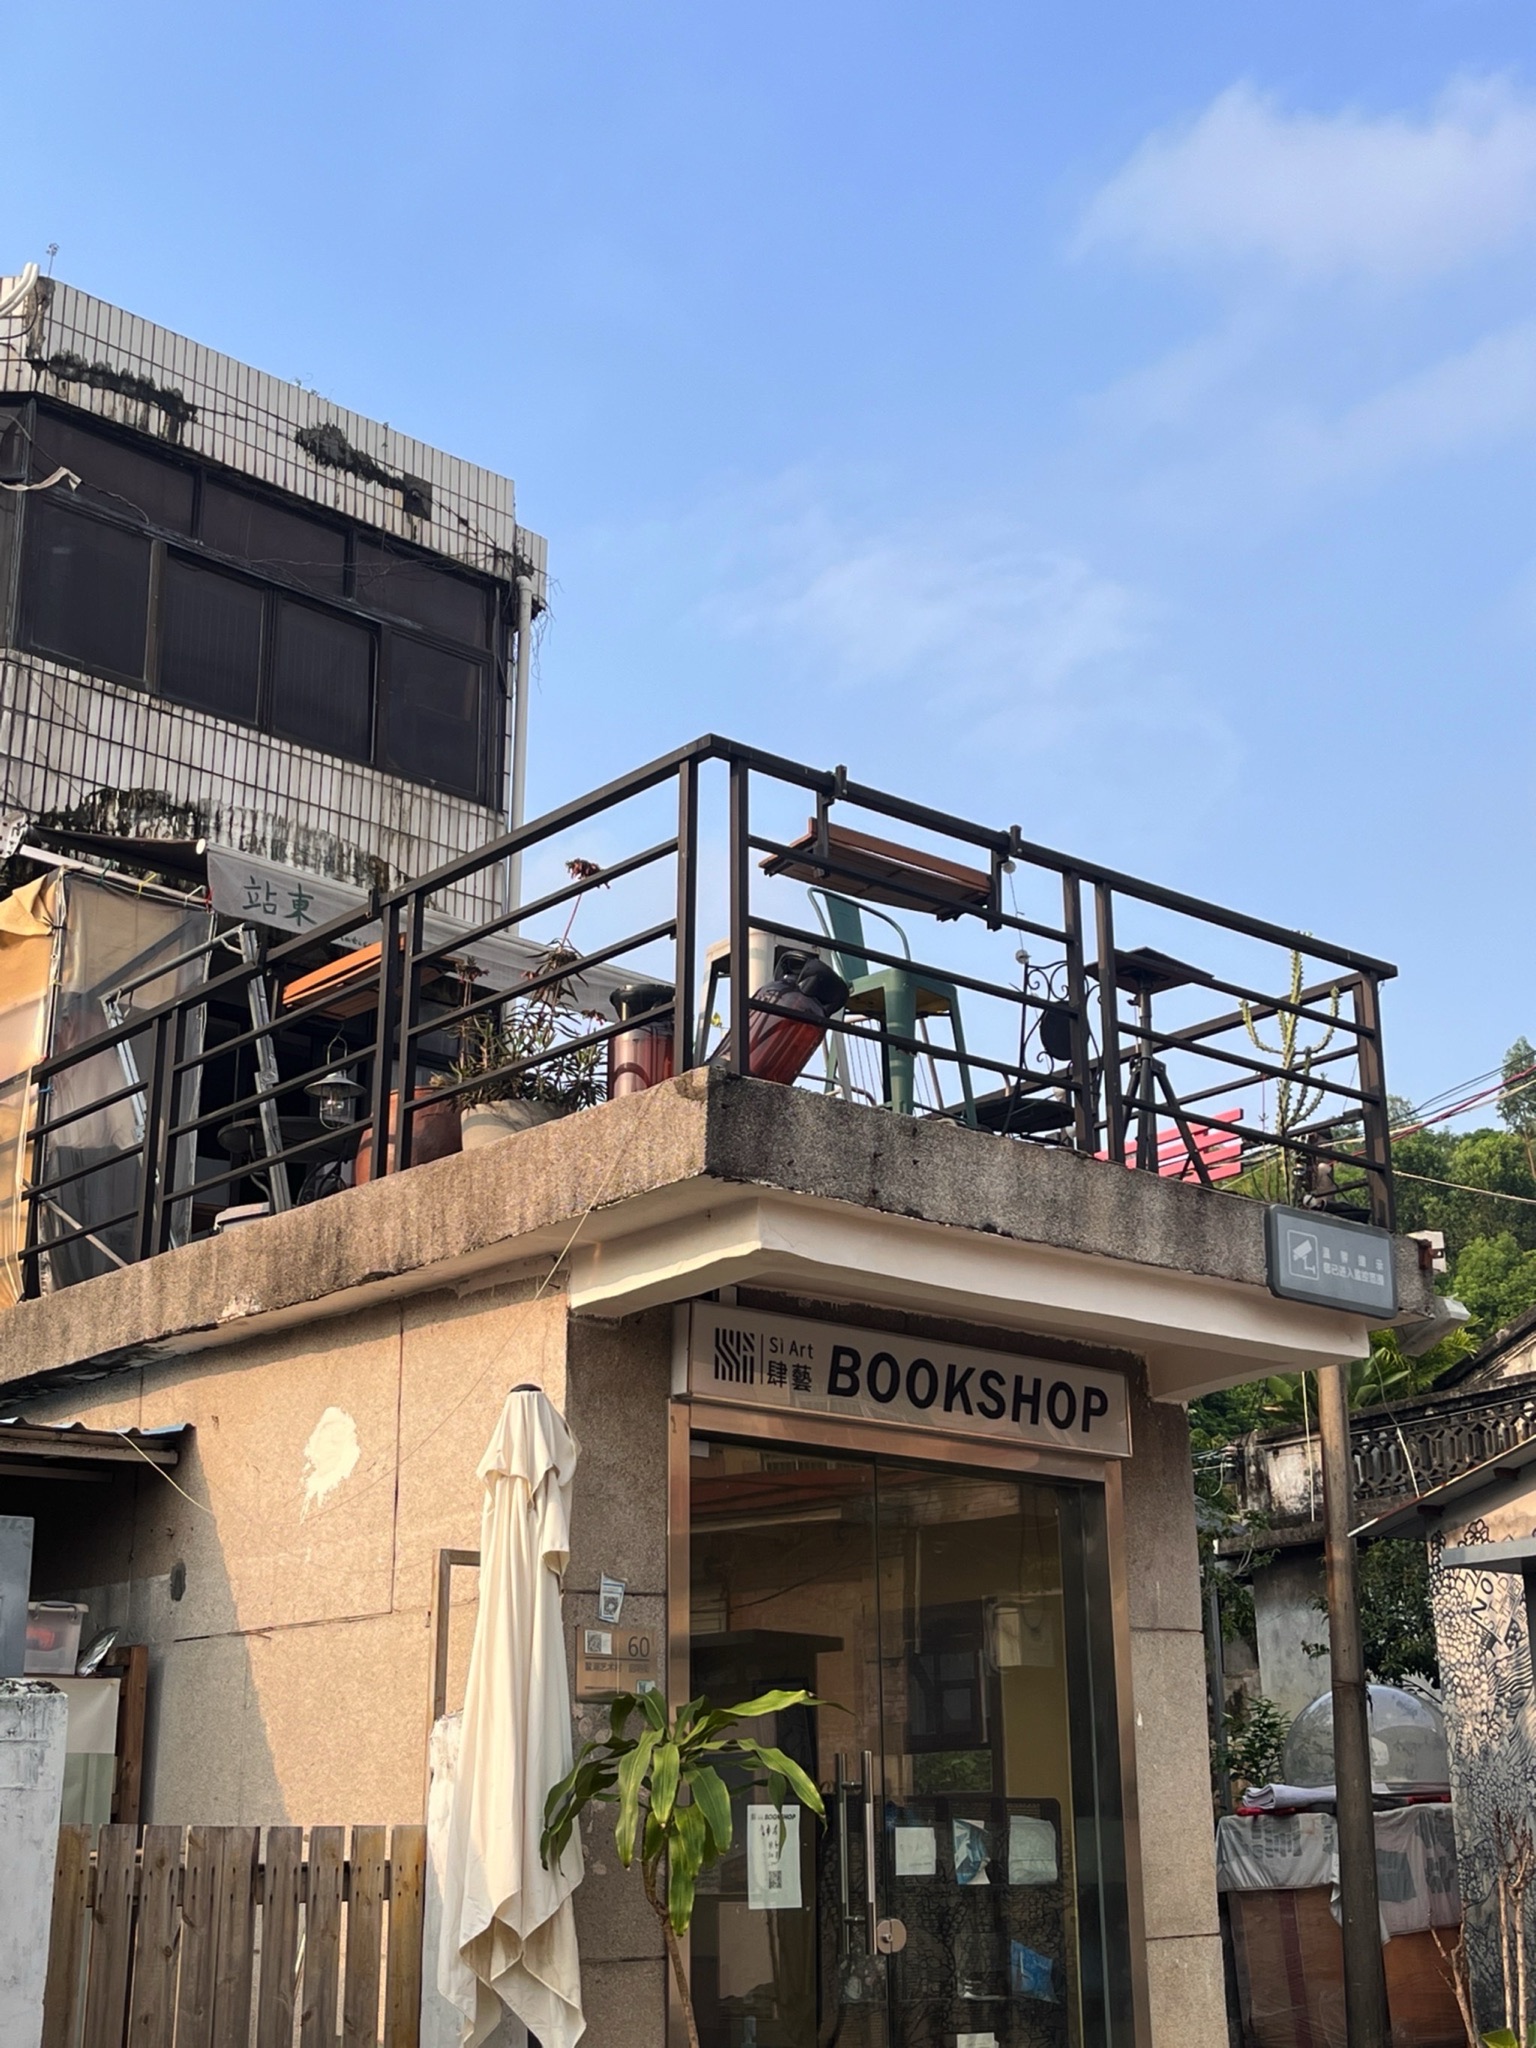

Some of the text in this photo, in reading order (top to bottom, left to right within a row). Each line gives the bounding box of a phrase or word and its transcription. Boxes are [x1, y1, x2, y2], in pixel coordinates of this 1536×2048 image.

[789, 1340, 814, 1360] Art
[827, 1344, 1108, 1433] BOOKSHOP
[628, 1636, 650, 1658] 60
